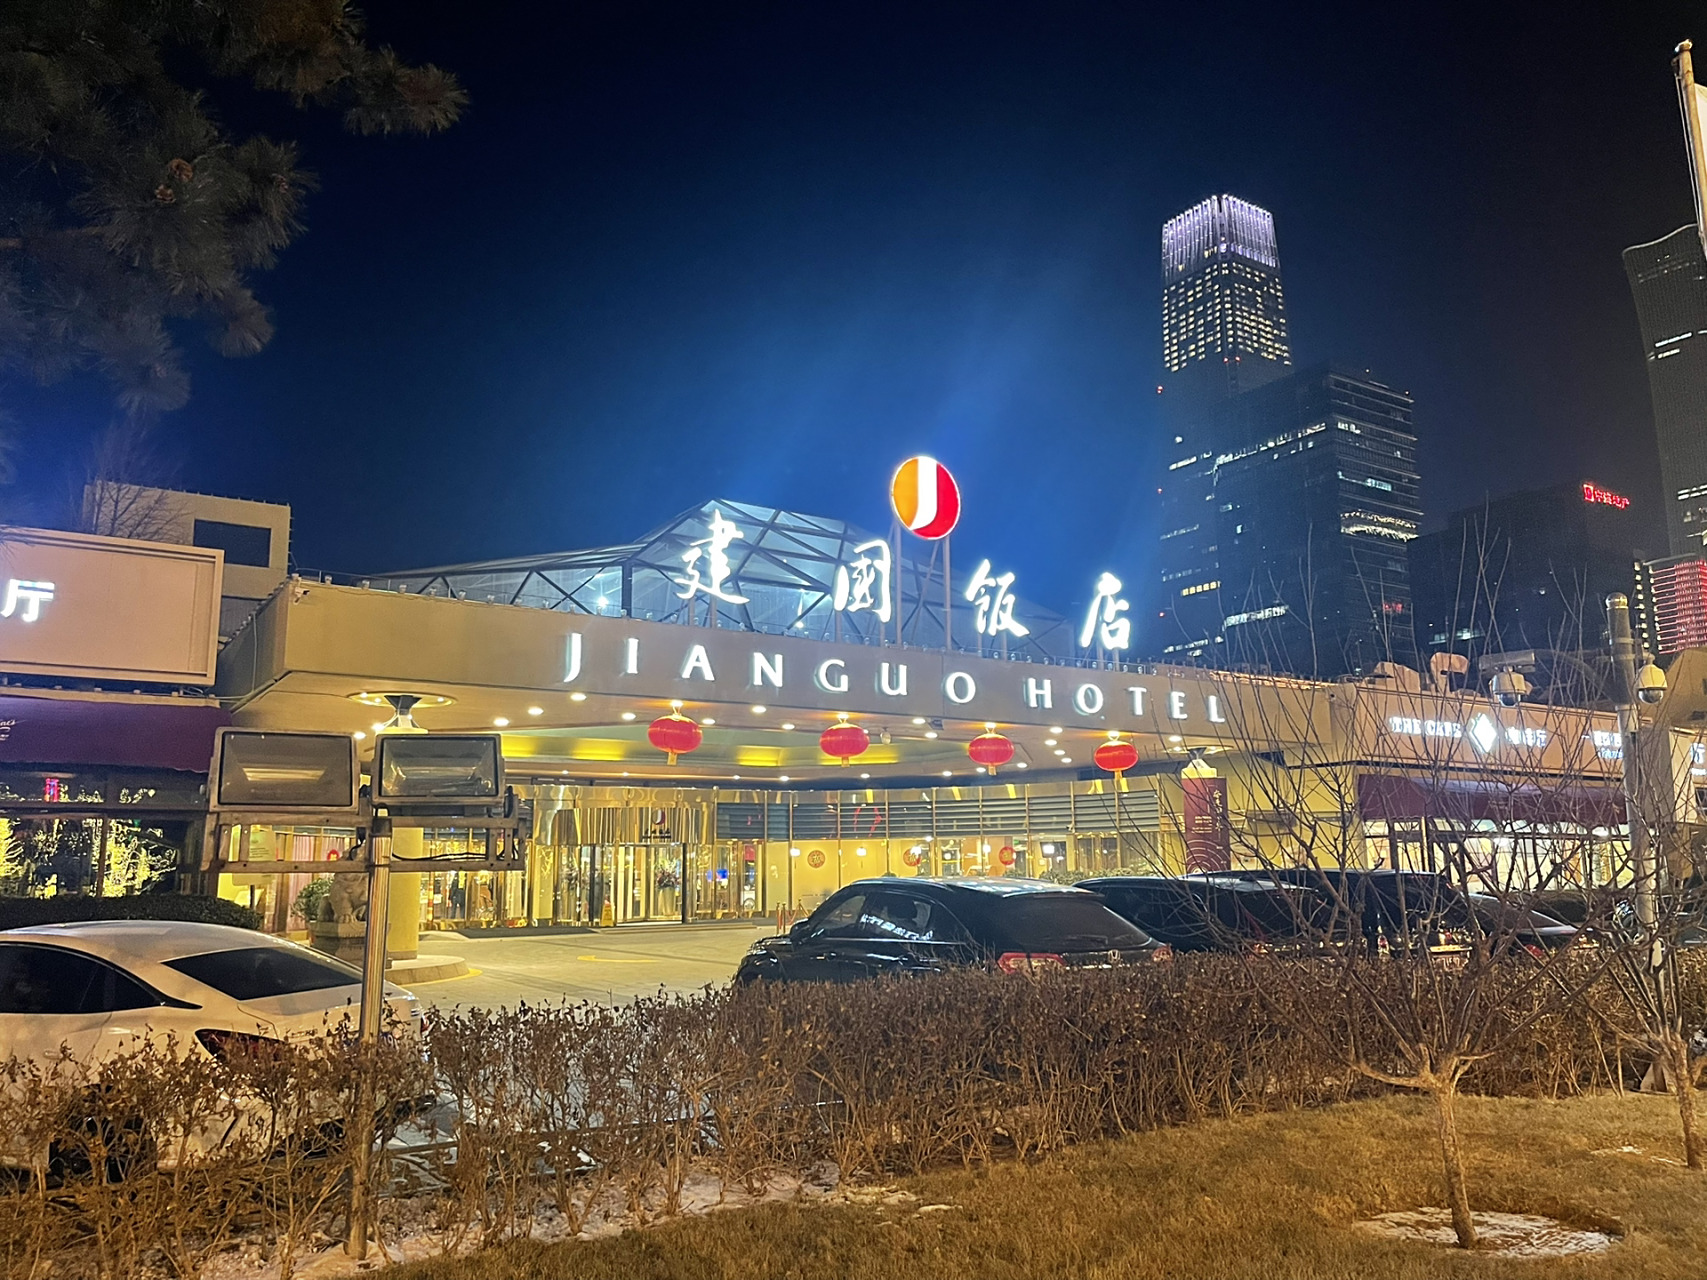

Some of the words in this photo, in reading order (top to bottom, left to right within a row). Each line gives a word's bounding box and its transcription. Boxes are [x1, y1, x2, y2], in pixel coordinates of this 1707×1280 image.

[0, 579, 55, 623] 厅
[563, 632, 977, 704] JIANGUO
[1026, 677, 1226, 723] HOTEL
[1391, 717, 1421, 733] THE
